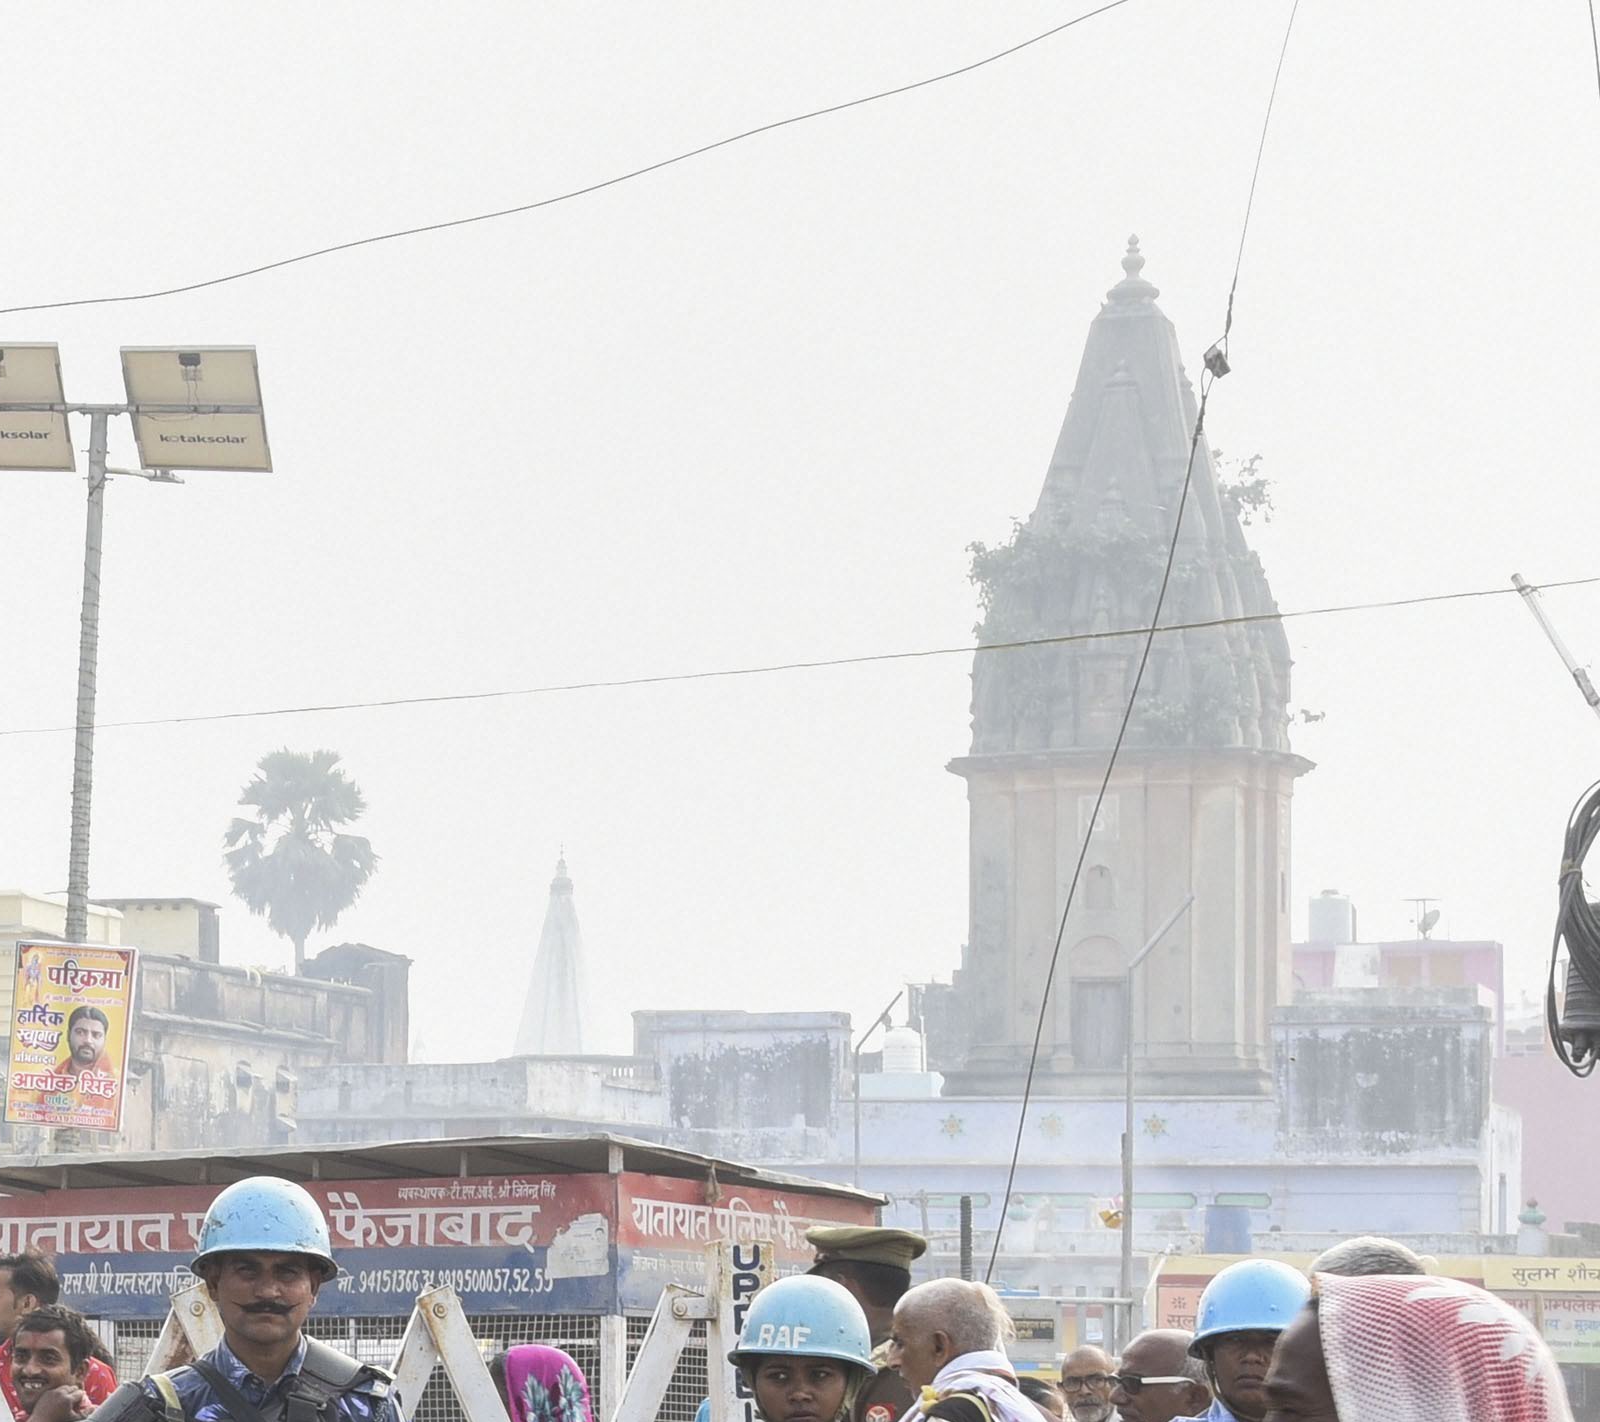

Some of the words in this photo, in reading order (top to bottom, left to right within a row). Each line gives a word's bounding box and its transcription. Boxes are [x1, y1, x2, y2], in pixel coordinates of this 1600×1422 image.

[160, 434, 248, 445] kotaksolar
[17, 1003, 64, 1027] हार्दिक
[13, 1069, 76, 1092] आलोक
[79, 1070, 117, 1098] सिंह
[498, 1178, 511, 1200] श्री
[632, 1197, 712, 1241] यातायात
[1512, 1266, 1560, 1287] सुलभ
[757, 1323, 812, 1349] RAF
